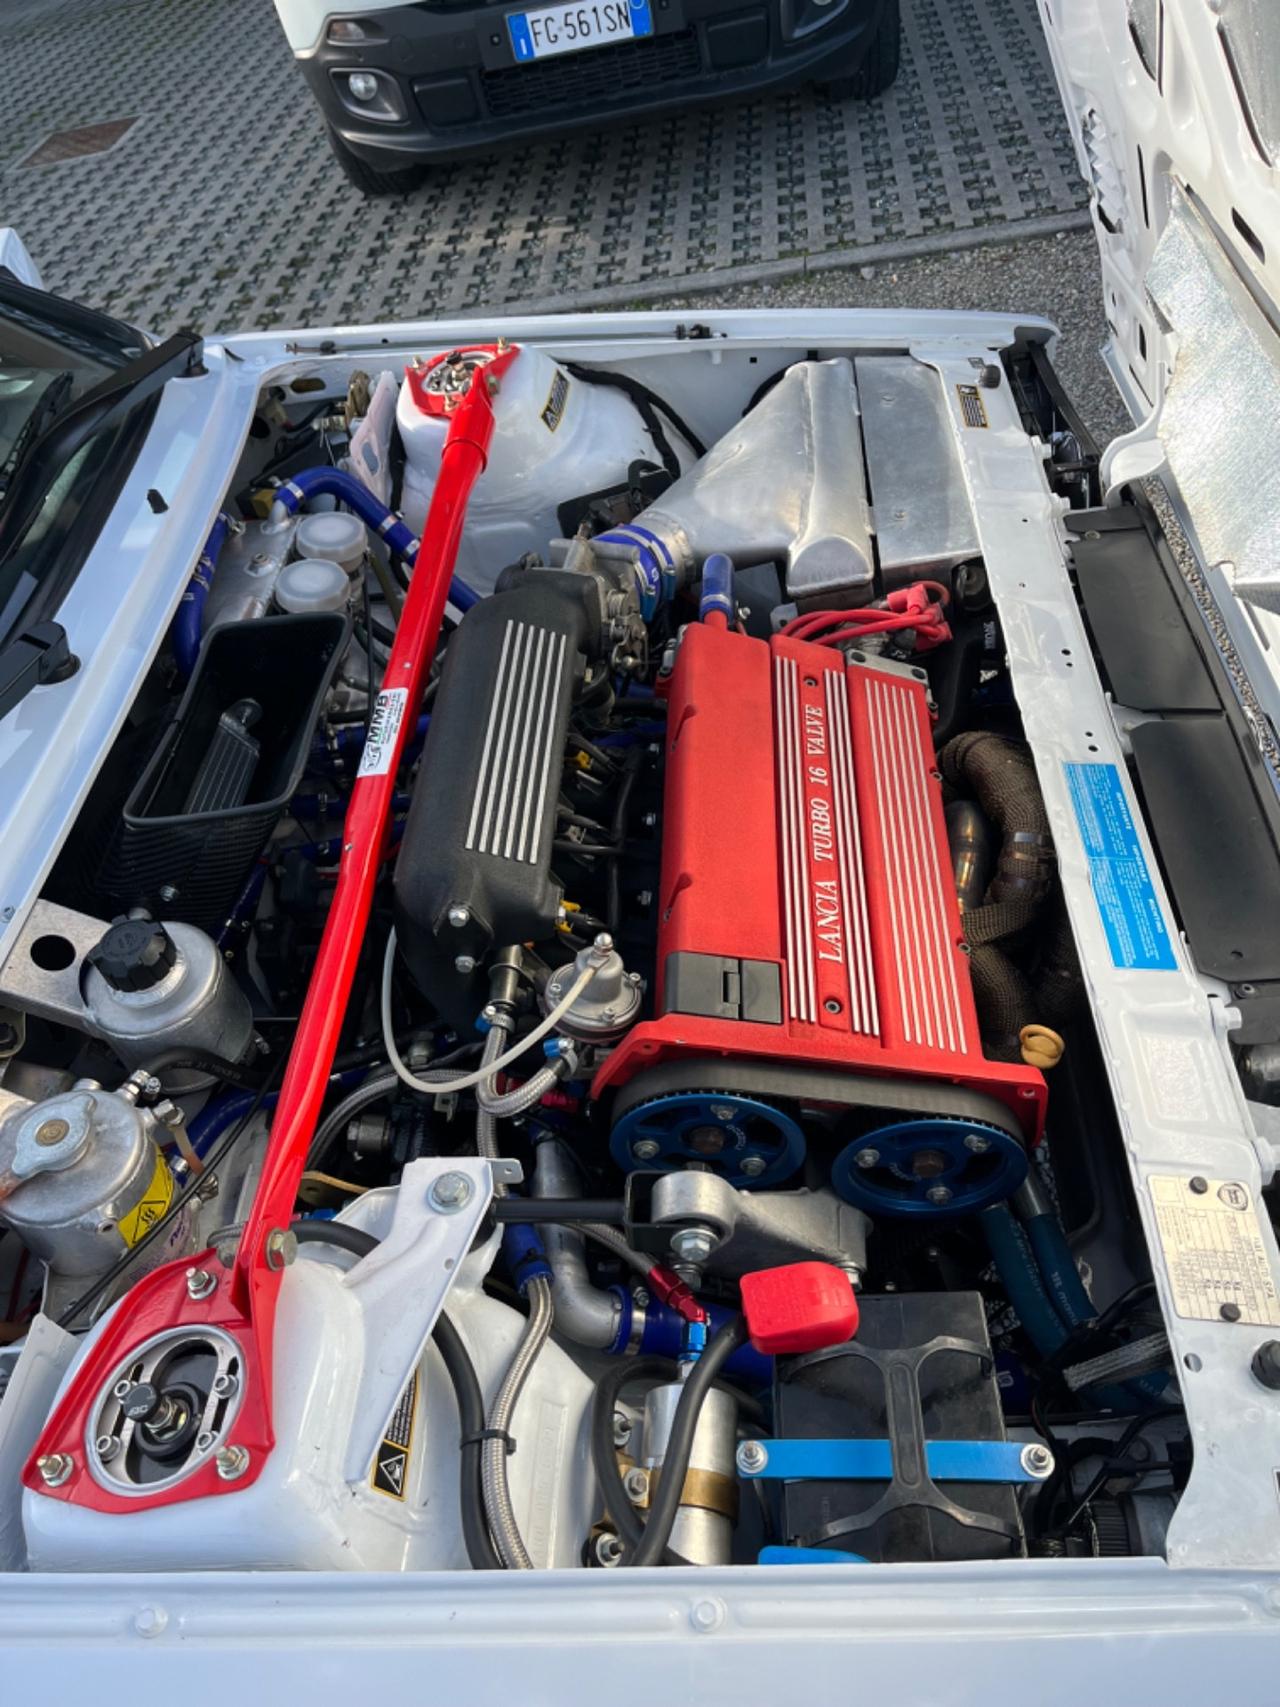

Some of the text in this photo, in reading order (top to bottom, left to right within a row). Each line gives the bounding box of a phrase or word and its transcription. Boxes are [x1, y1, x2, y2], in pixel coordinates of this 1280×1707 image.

[530, 1, 631, 47] FG 561SN
[368, 695, 389, 743] MMB
[805, 704, 843, 964] LANCIA TURBO 16 VALVE
